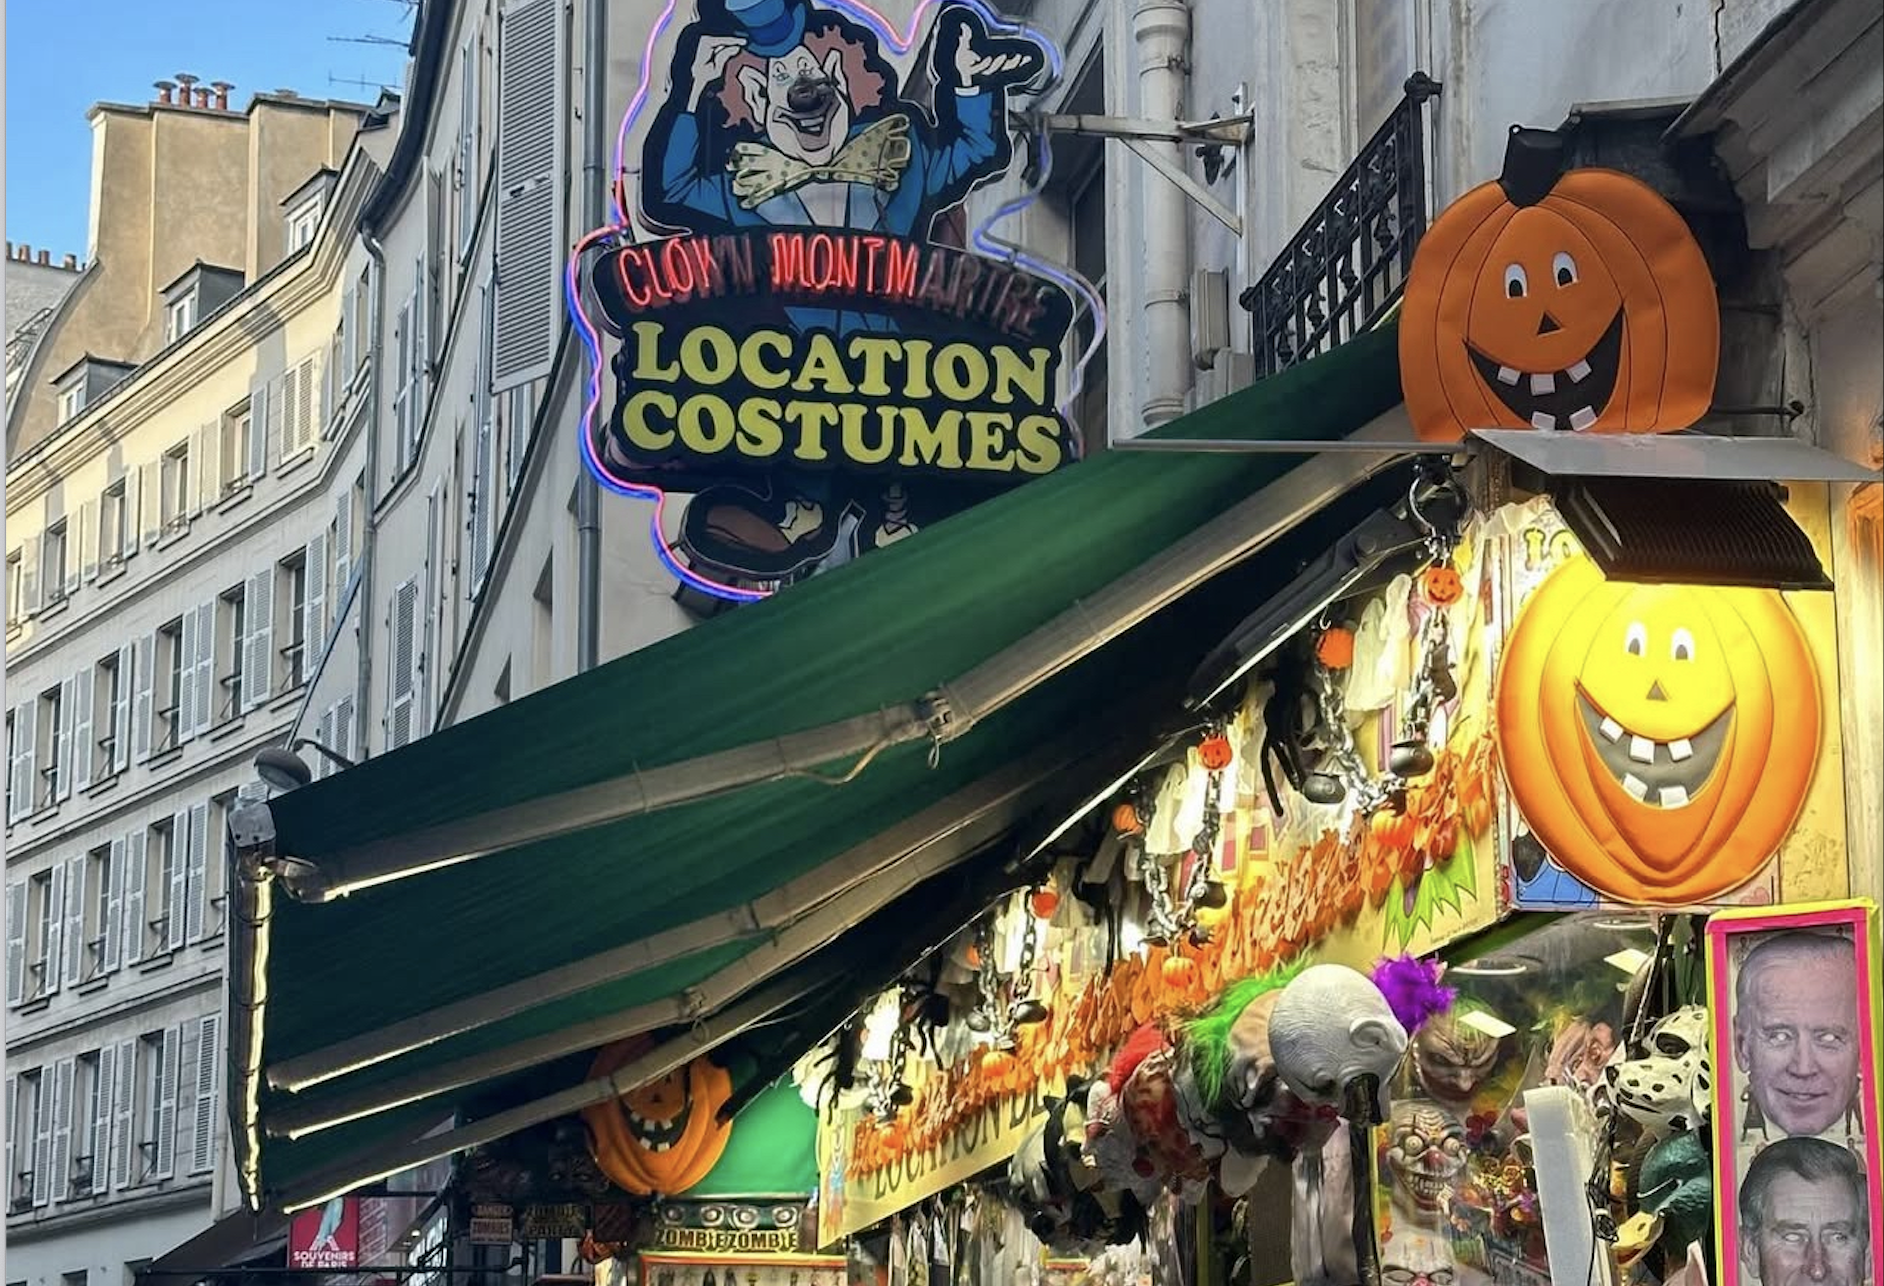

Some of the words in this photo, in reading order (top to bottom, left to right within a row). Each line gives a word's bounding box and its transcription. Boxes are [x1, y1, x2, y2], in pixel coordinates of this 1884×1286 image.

[617, 231, 754, 309] CLOWN
[769, 232, 1055, 336] MONTMARTRE
[631, 320, 1052, 406] LOCATION
[622, 389, 1061, 474] COSTUMES
[293, 1250, 355, 1262] SOUVENIRS
